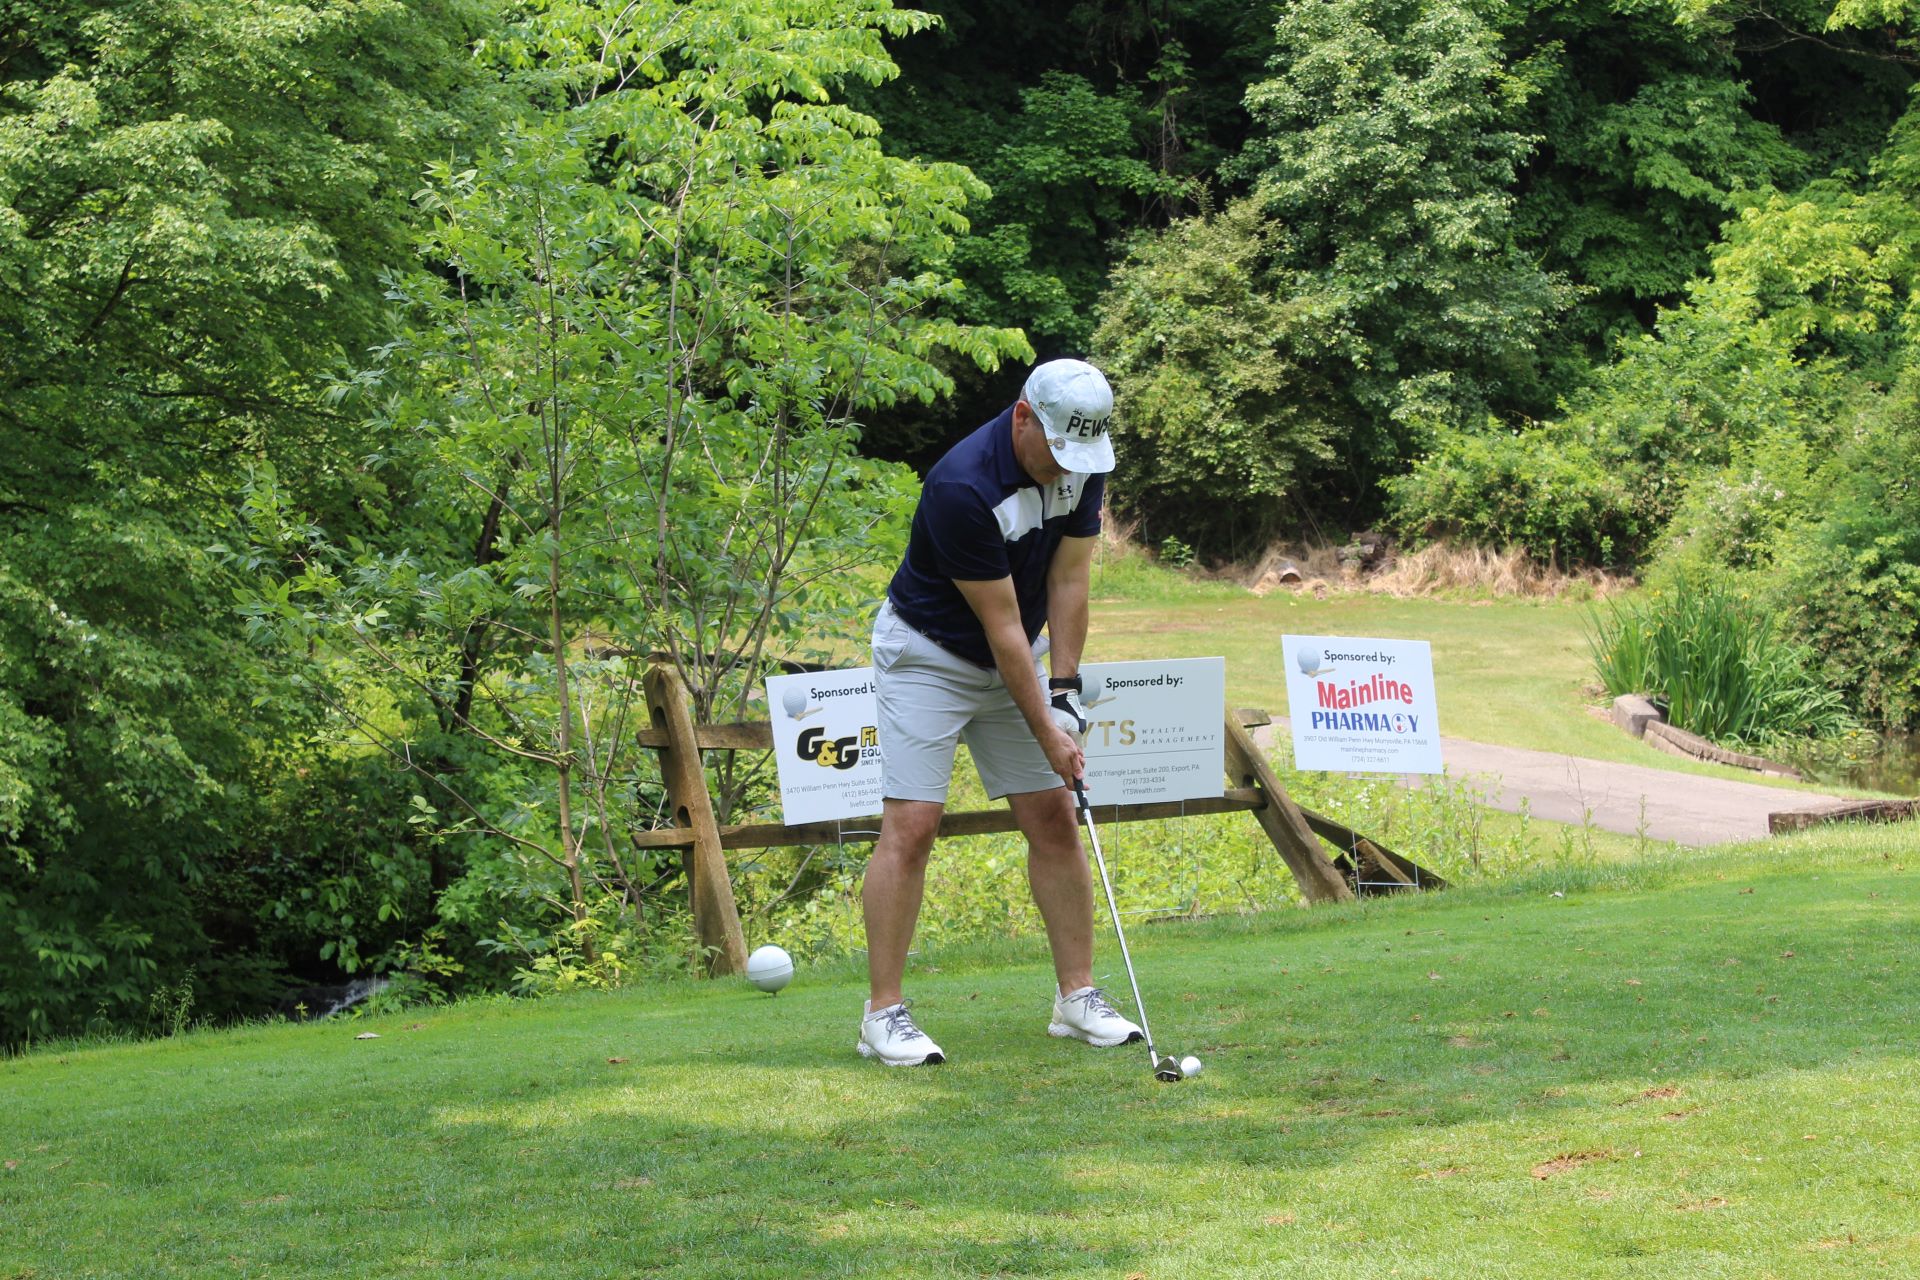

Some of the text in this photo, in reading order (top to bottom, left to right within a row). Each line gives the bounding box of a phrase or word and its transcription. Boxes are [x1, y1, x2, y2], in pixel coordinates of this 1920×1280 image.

[1324, 650, 1396, 665] Sponsored by:
[1105, 674, 1184, 691] Sponsored by:
[810, 682, 868, 701] Sponsored
[1317, 673, 1413, 710] Mainline
[1311, 711, 1419, 734] PHARMACY
[1141, 726, 1185, 735] WEALTH
[1141, 734, 1216, 745] MANAGEMENT
[796, 726, 860, 771] G&G
[1103, 768, 1126, 777] Triangle
[1191, 763, 1200, 771] PA
[801, 784, 822, 793] William
[822, 782, 837, 791] Penn
[838, 781, 850, 789] Hwy
[851, 779, 866, 788] Suite
[1122, 786, 1167, 795] YTSWealth.com
[842, 790, 857, 799] (412)
[850, 799, 879, 809] livefit.com
